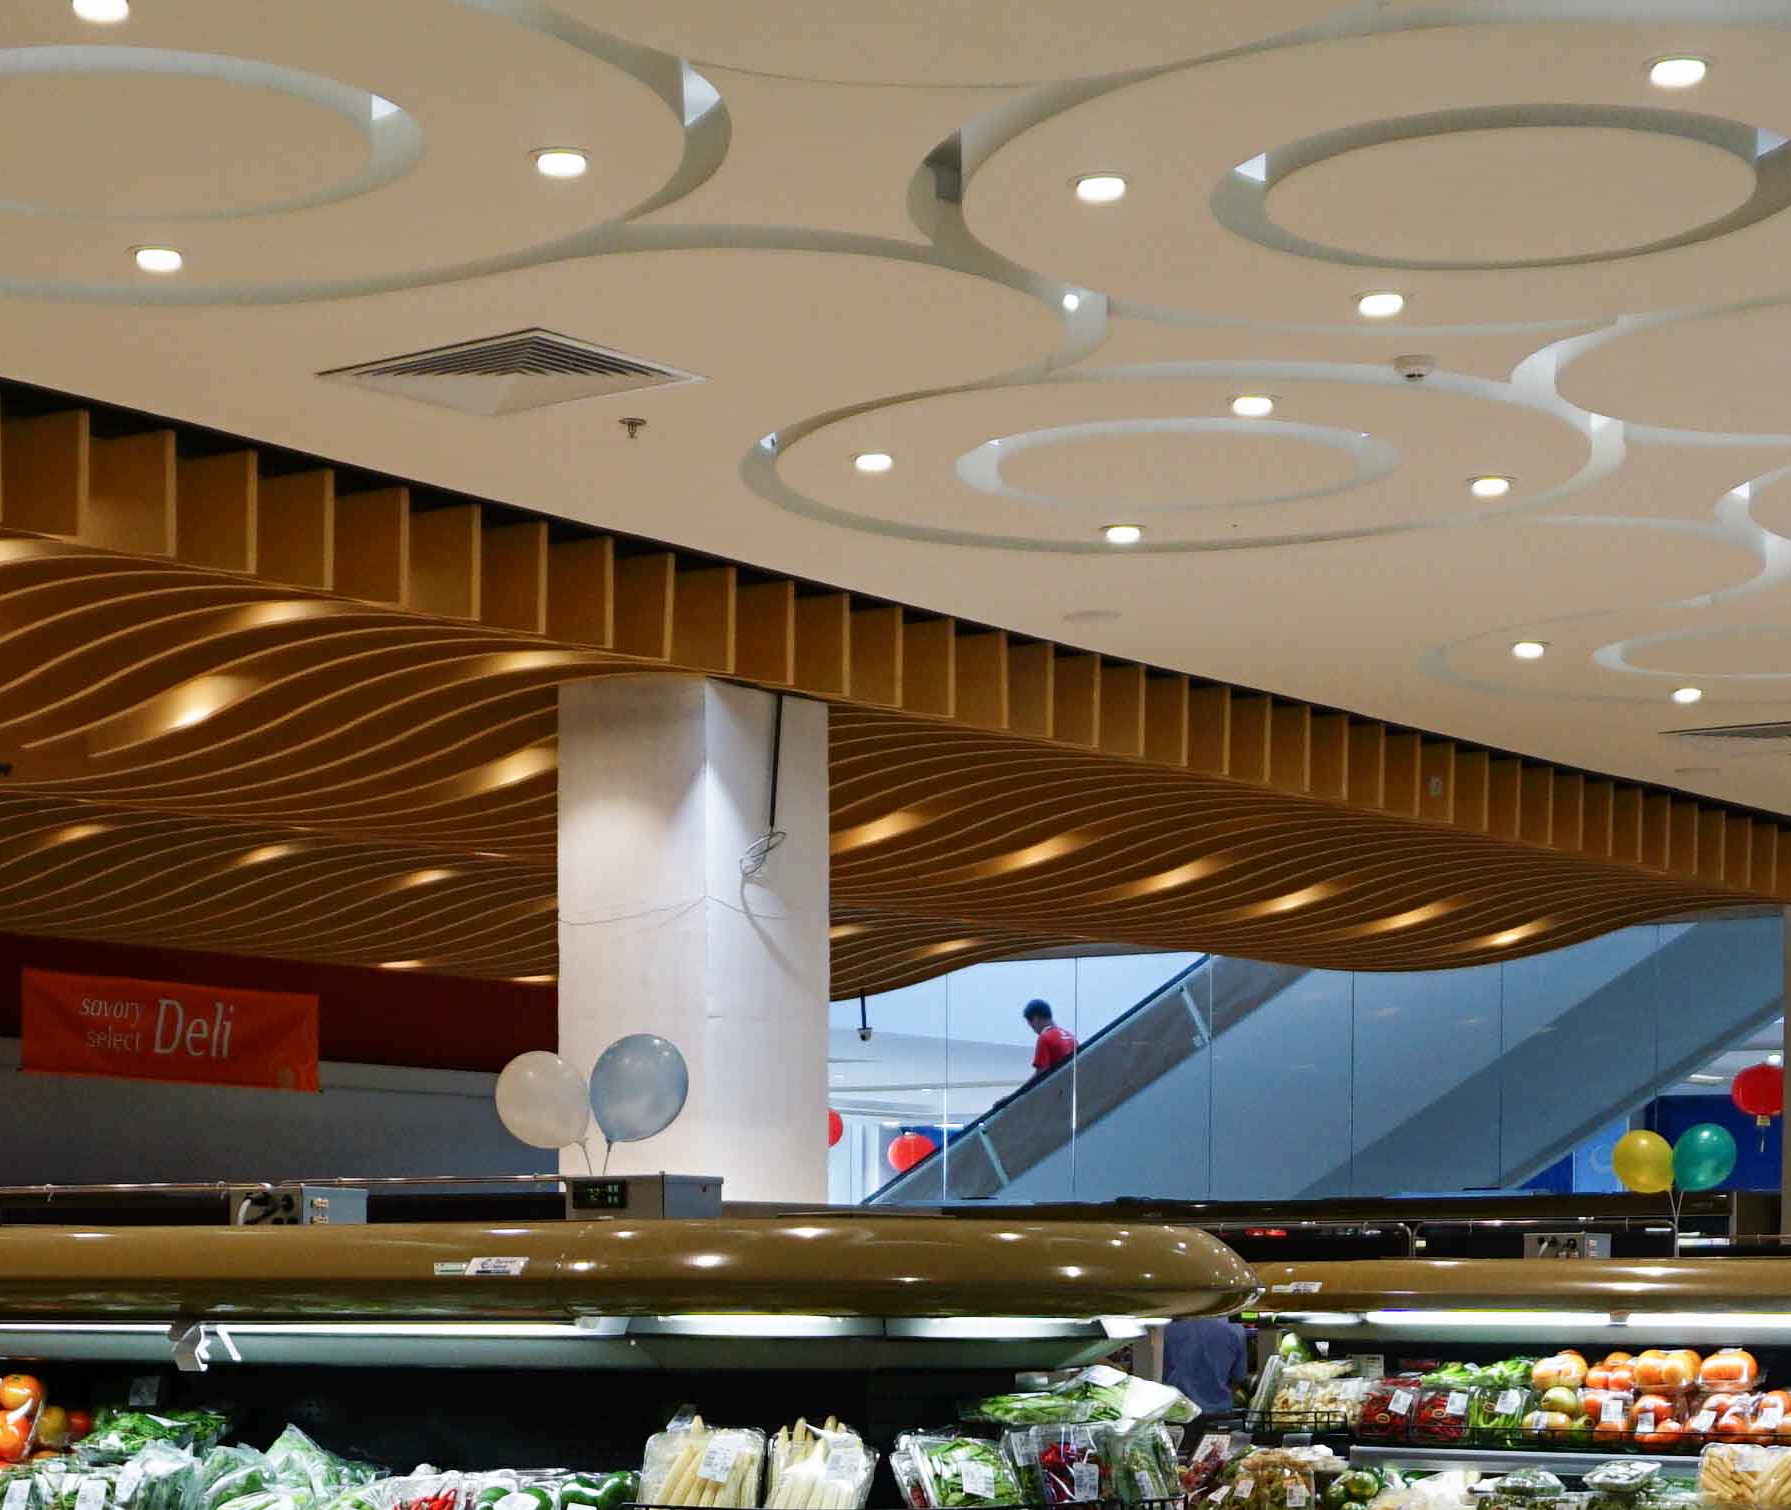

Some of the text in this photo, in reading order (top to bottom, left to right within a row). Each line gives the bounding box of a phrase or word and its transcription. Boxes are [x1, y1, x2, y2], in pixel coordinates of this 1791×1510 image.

[80, 995, 143, 1022] savory
[87, 1025, 143, 1054] select
[153, 997, 234, 1058] Deli
